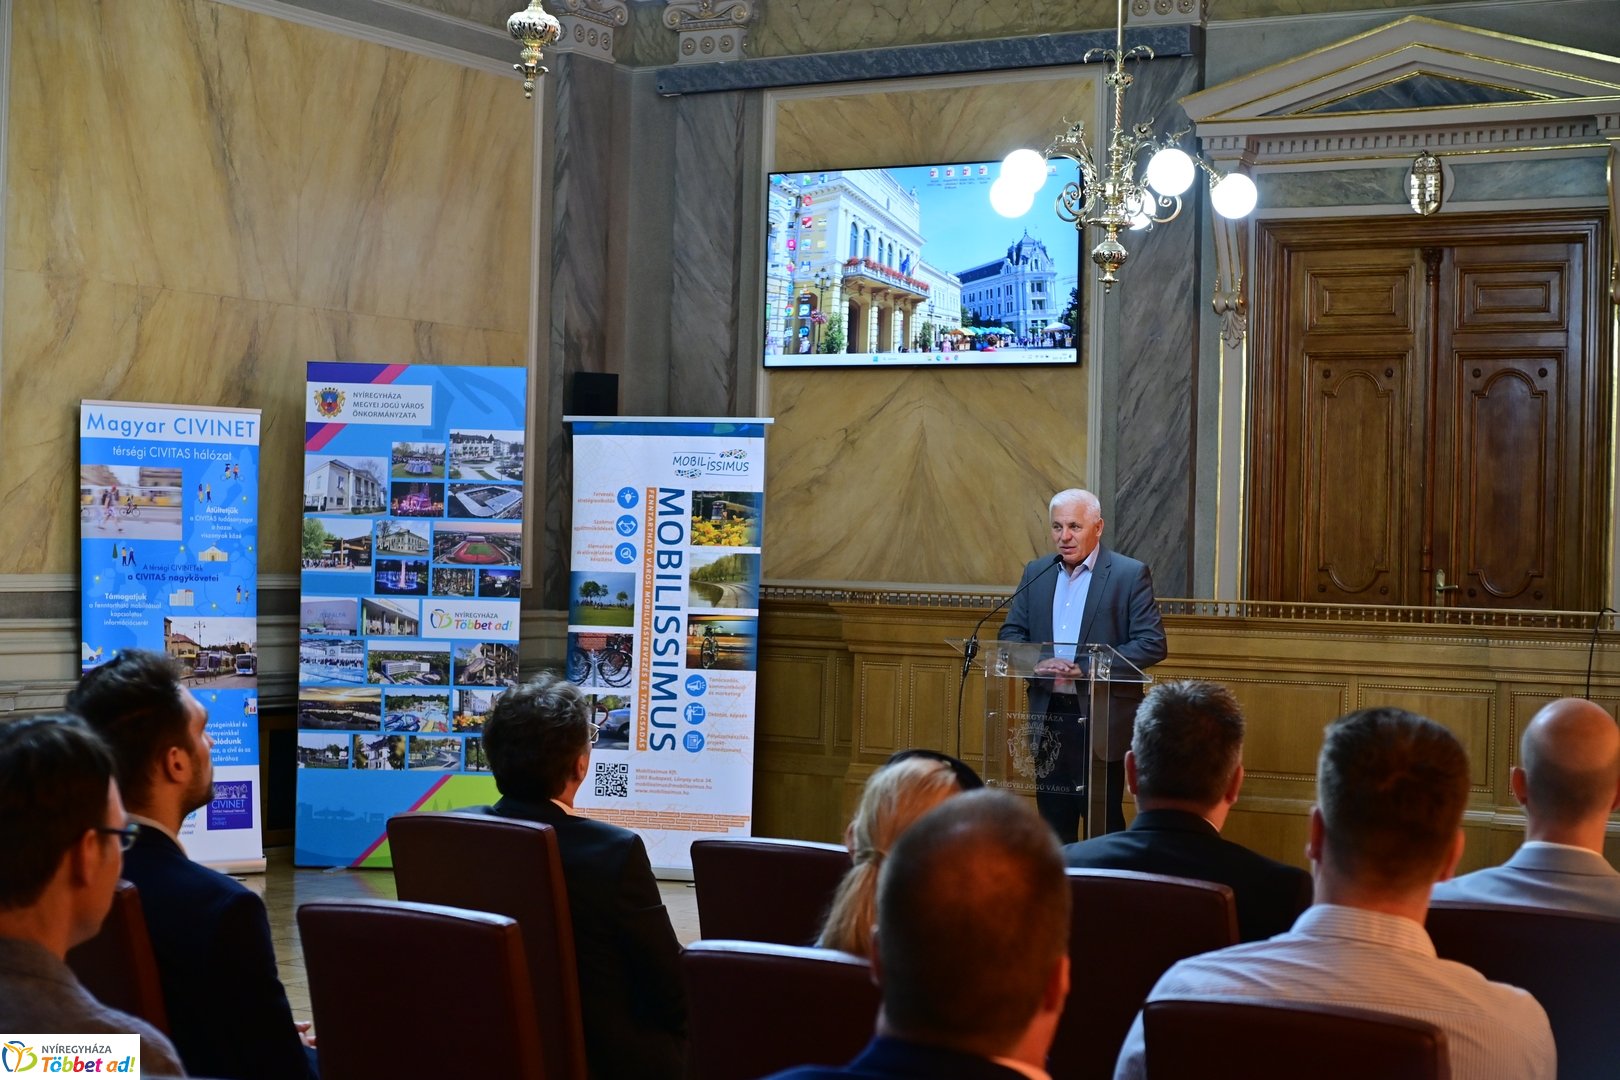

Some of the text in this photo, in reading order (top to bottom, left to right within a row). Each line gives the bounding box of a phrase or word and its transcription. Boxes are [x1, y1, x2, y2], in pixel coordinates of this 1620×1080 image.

[353, 410, 417, 418] ÖNKORMÁNYZATA
[86, 412, 255, 438] Magyar CIVINET
[112, 446, 232, 461] térségi CIVITAS hálózat
[135, 573, 166, 581] CIVITAS
[168, 574, 219, 583] nagykövetei
[105, 592, 147, 601] Támogatjuk
[454, 611, 499, 619] NYÍREGYHÁZA
[638, 489, 656, 749] FENNTARTHATÓ VÁROSI MOBILITÁSTERVEZÉS ÉS TANÁCSADÁS
[649, 487, 686, 751] MOBILISSIMUS
[454, 619, 513, 631] Többet ad!
[1006, 712, 1064, 722] NYÍREGYHÁZA
[1025, 782, 1045, 790] JOGÚ
[1046, 783, 1071, 792] VÁROS
[211, 799, 245, 809] CIVINET
